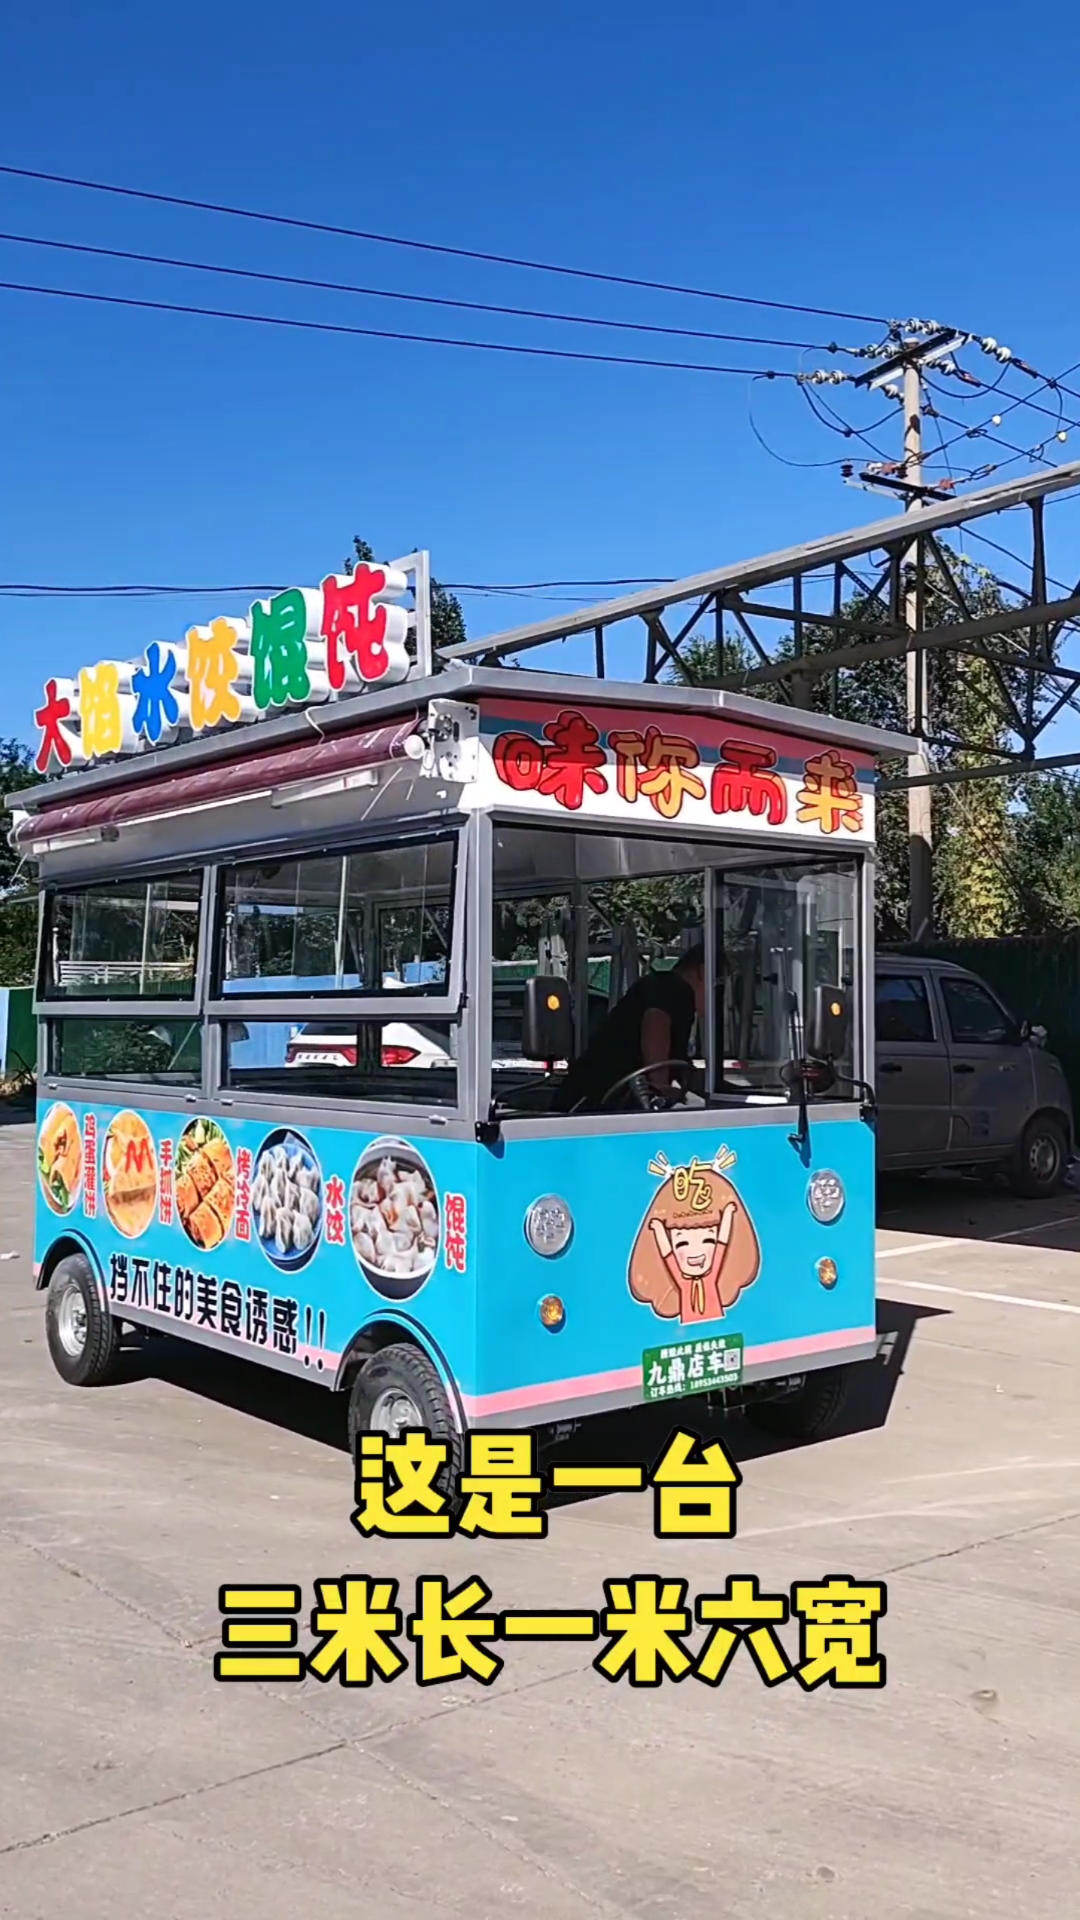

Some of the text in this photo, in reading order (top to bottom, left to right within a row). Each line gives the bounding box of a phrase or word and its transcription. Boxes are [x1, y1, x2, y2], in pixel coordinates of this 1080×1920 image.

[35, 562, 390, 773] 大馅水饺馄饨
[492, 709, 864, 834] 味你而来
[160, 1139, 173, 1224] 手抓饼
[235, 1148, 251, 1240] 烤冷面
[326, 1176, 344, 1243] 水饺
[445, 1194, 465, 1271] 馄饨
[647, 1350, 725, 1386] 九鼎店车
